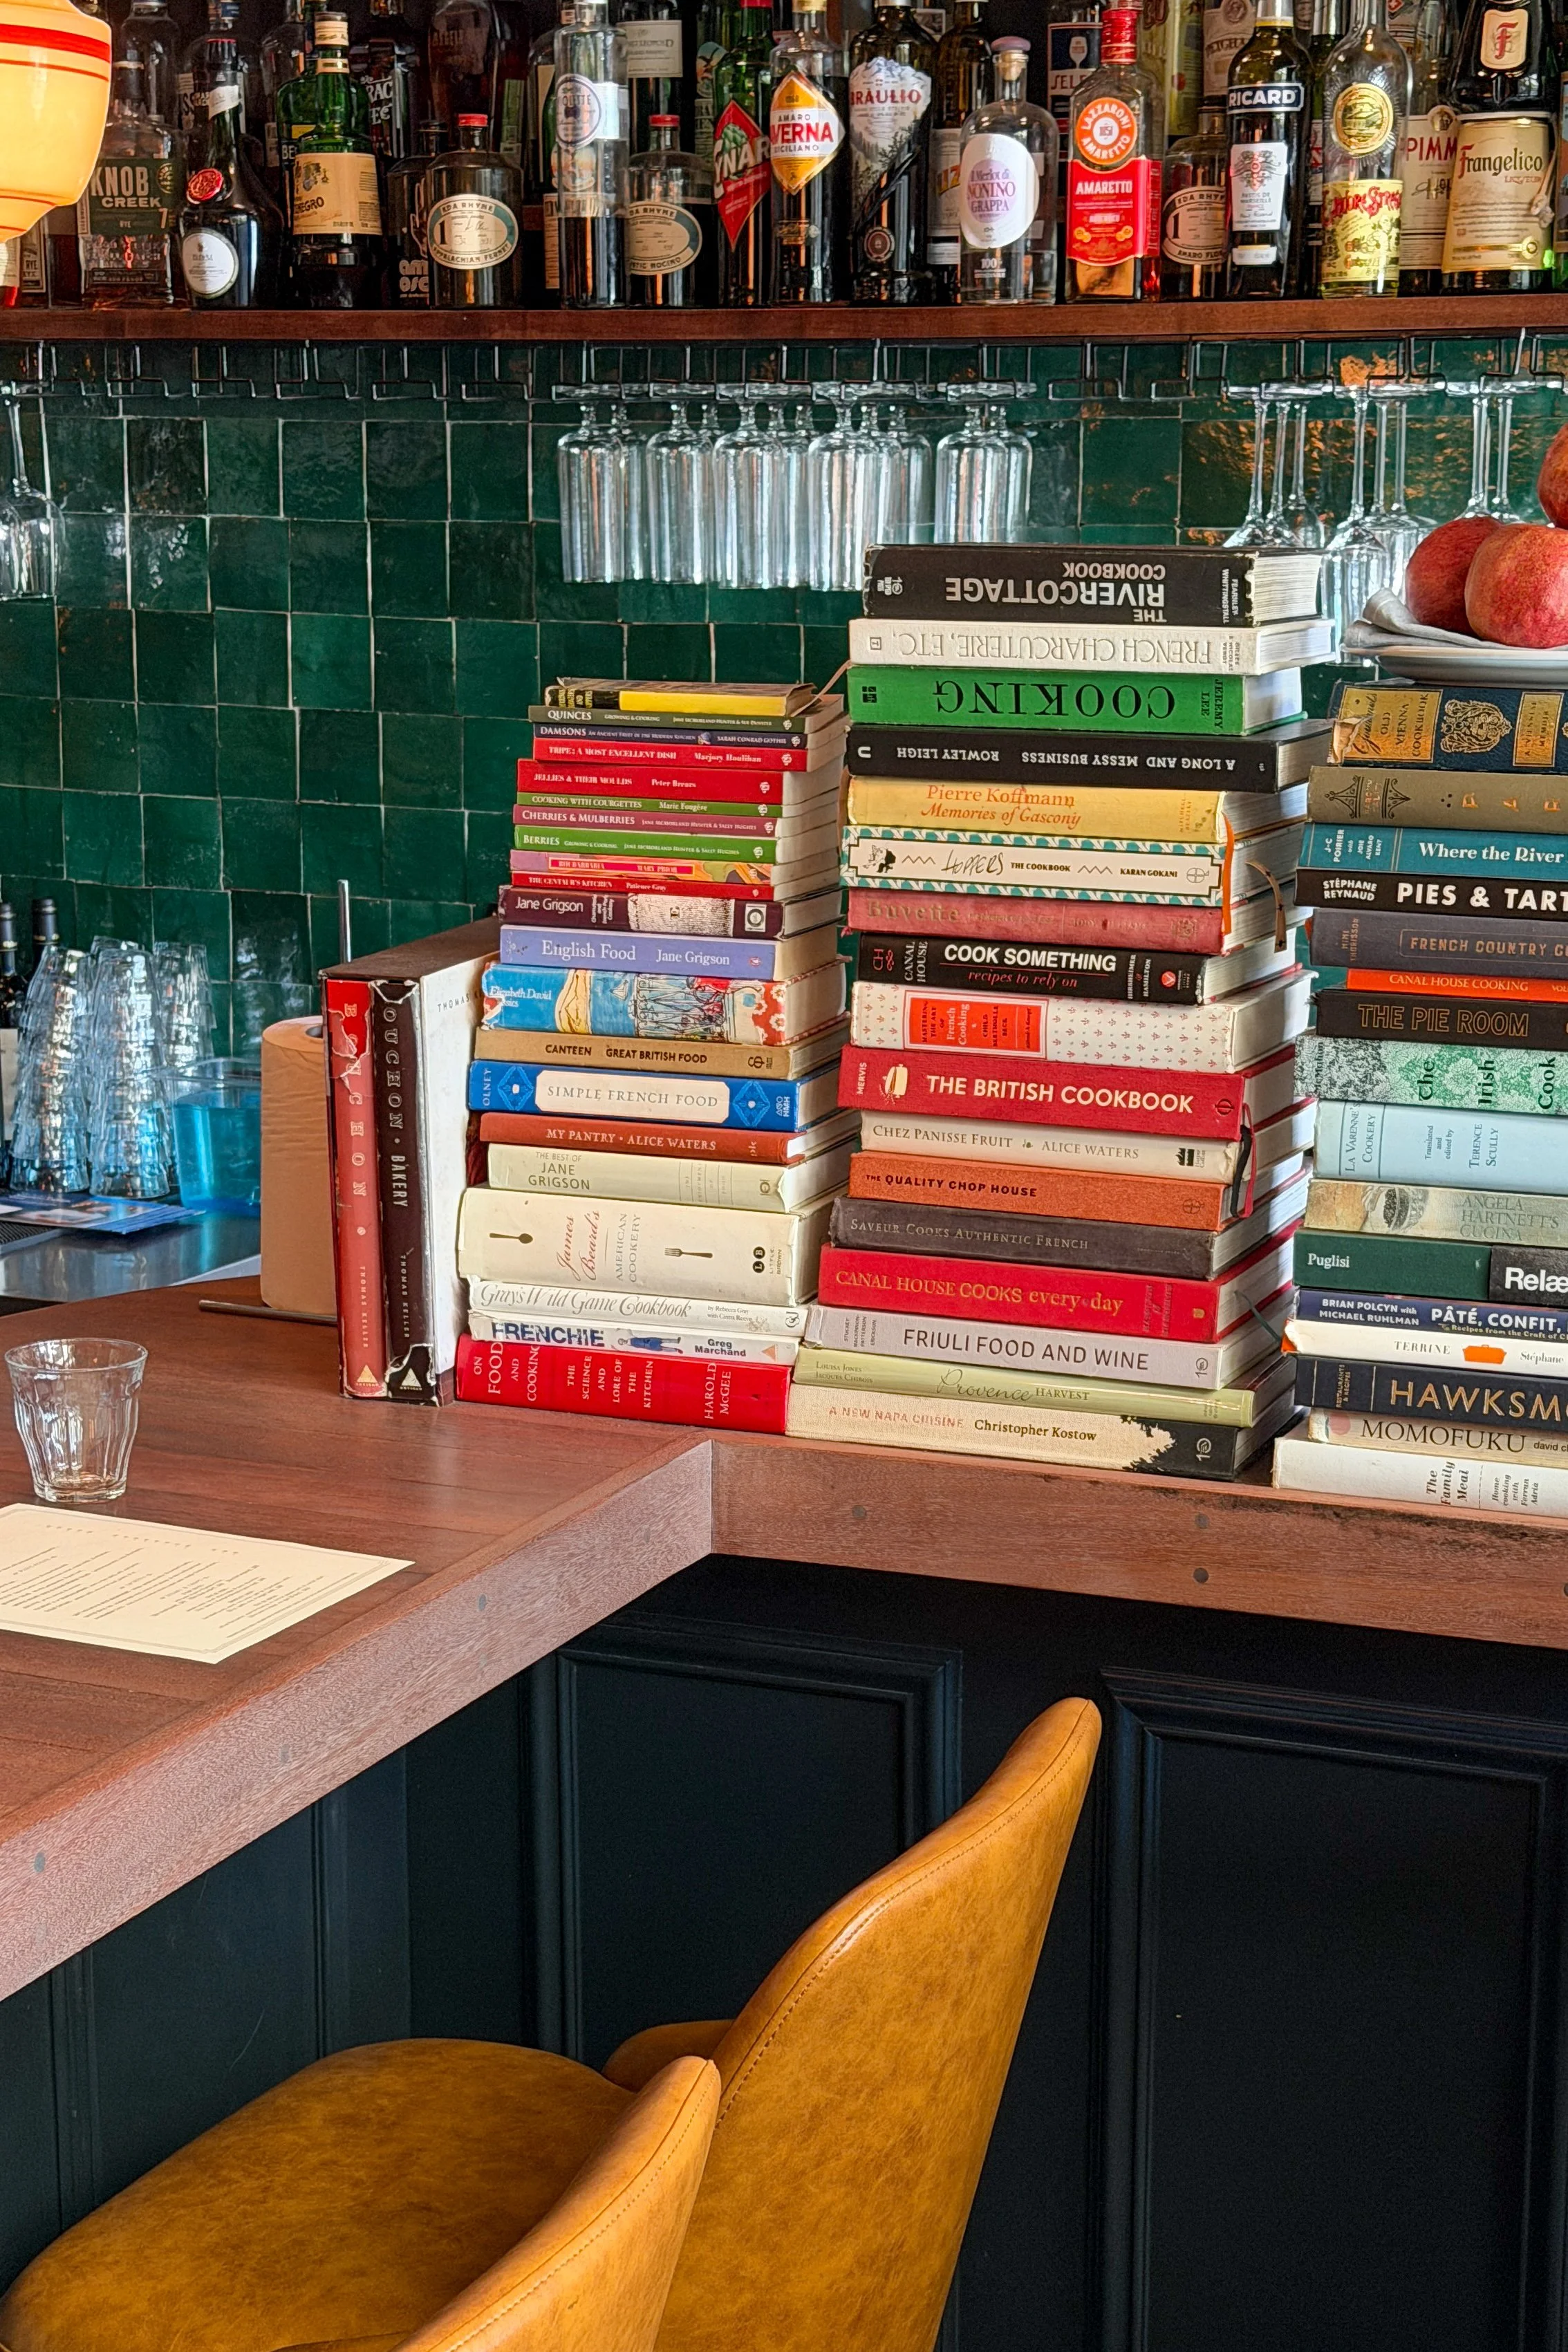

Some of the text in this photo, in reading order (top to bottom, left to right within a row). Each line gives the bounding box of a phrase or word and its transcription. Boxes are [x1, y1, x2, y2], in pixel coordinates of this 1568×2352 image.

[1229, 89, 1296, 107] RICARD
[778, 113, 812, 123] AMARO
[1081, 102, 1132, 131] LAZZARONI
[1081, 135, 1131, 160] AMARETTO
[1457, 143, 1544, 180] Frangelico
[91, 166, 149, 197] KNOB
[966, 181, 1016, 200] NONINO
[1074, 180, 1134, 196] AMARETTO
[101, 196, 162, 208] CREEK
[970, 198, 1011, 214] GRAPPA
[1063, 562, 1166, 580] COOKBOOK
[1132, 608, 1167, 623] THE
[893, 632, 1213, 664] FRENCH CHARCUTERIE, ETC.
[932, 680, 1175, 720] COOKING
[1201, 691, 1210, 716] LEE
[1214, 678, 1223, 729] JEREMY
[547, 709, 592, 722] QUINCES
[539, 726, 587, 737] DAMSONS
[897, 746, 1000, 761] ROWLEY LEIGH
[1021, 750, 1235, 771] A LONG AND MESSY BUSINESS
[531, 796, 643, 809] COOKING WITH COURGETTES
[926, 785, 1076, 809] Pierre Koffmann
[921, 802, 1081, 830] Memories of Gascony
[1419, 841, 1565, 864] Where the River
[1010, 861, 1071, 873] THE COOKBOOK
[1119, 868, 1178, 879] KARAN GOKANI
[1322, 877, 1378, 893] STÉPHANE
[1323, 889, 1375, 902] REYNAUD
[1397, 882, 1491, 908] PIES &
[515, 896, 584, 914] Jane Grigson
[542, 940, 637, 961] English Food
[655, 949, 731, 967] Jane Grigson
[944, 944, 1117, 972] COOK SOMETHING
[1410, 936, 1548, 957] FRENCH COUNTRY
[968, 971, 1078, 991] recipes to rely on
[1389, 973, 1529, 992] CANAL HOUSE COOKING
[1357, 1003, 1529, 1037] THE PIE ROOM
[545, 1044, 592, 1056] CANTEEN
[606, 1047, 708, 1064] GREAT BRITISH FOOD
[483, 1067, 492, 1106] OLNEY
[857, 1062, 867, 1095] MERVIS
[1417, 1060, 1436, 1101] The
[1477, 1059, 1495, 1106] Irish
[1537, 1056, 1557, 1110] Cook
[547, 1085, 718, 1108] SIMPLE FRENCH FOOD
[926, 1075, 1194, 1114] THE BRITISH COOKBOOK
[545, 1128, 616, 1144] MY PANTRY
[627, 1135, 717, 1152] ALICE WATERS
[872, 1124, 1013, 1148] CHEZ PANISSE FRUIT
[1040, 1141, 1139, 1160] ALICE WATERS
[541, 1163, 575, 1175] JANE
[390, 1155, 409, 1208] BAKERY
[528, 1175, 590, 1191] GRIGSON
[865, 1174, 1038, 1198] THE QUALITY CHOP HOUSE
[556, 1215, 582, 1282] James
[614, 1212, 628, 1282] AMERICAN
[628, 1213, 642, 1283] COOKERY
[1307, 1253, 1350, 1269] Puglisi
[480, 1283, 693, 1318] Gray's Wild Game Cookbook
[835, 1269, 1125, 1316] CANAL HOUSE COOKS every day
[1319, 1310, 1419, 1326] MICHAEL RUHLMAN
[1322, 1298, 1417, 1315] BRIAN POLCYN with
[1431, 1306, 1561, 1334] PÂTÉ, CONFIT,
[490, 1322, 606, 1347] FRENCHIE
[707, 1338, 734, 1350] Greg
[693, 1345, 747, 1359] Marchand
[904, 1329, 1150, 1371] FRIULI FOOD AND WINE
[1394, 1341, 1451, 1355] TERRINE
[474, 1356, 483, 1376] ON
[487, 1341, 505, 1395] FOOD
[510, 1357, 520, 1381] AND
[567, 1364, 577, 1387] THE
[581, 1354, 592, 1401] SCIENCE
[597, 1367, 606, 1391] AND
[612, 1359, 623, 1403] LORE OF
[628, 1372, 637, 1394] THE
[643, 1360, 654, 1409] KITCHEN
[703, 1363, 718, 1420] HAROLD
[974, 1418, 1097, 1441] Christopher Kostow
[1360, 1419, 1527, 1453] MOMOFUKU
[1426, 1469, 1439, 1495] The
[1441, 1460, 1457, 1506] Family
[1457, 1469, 1470, 1502] Meal
